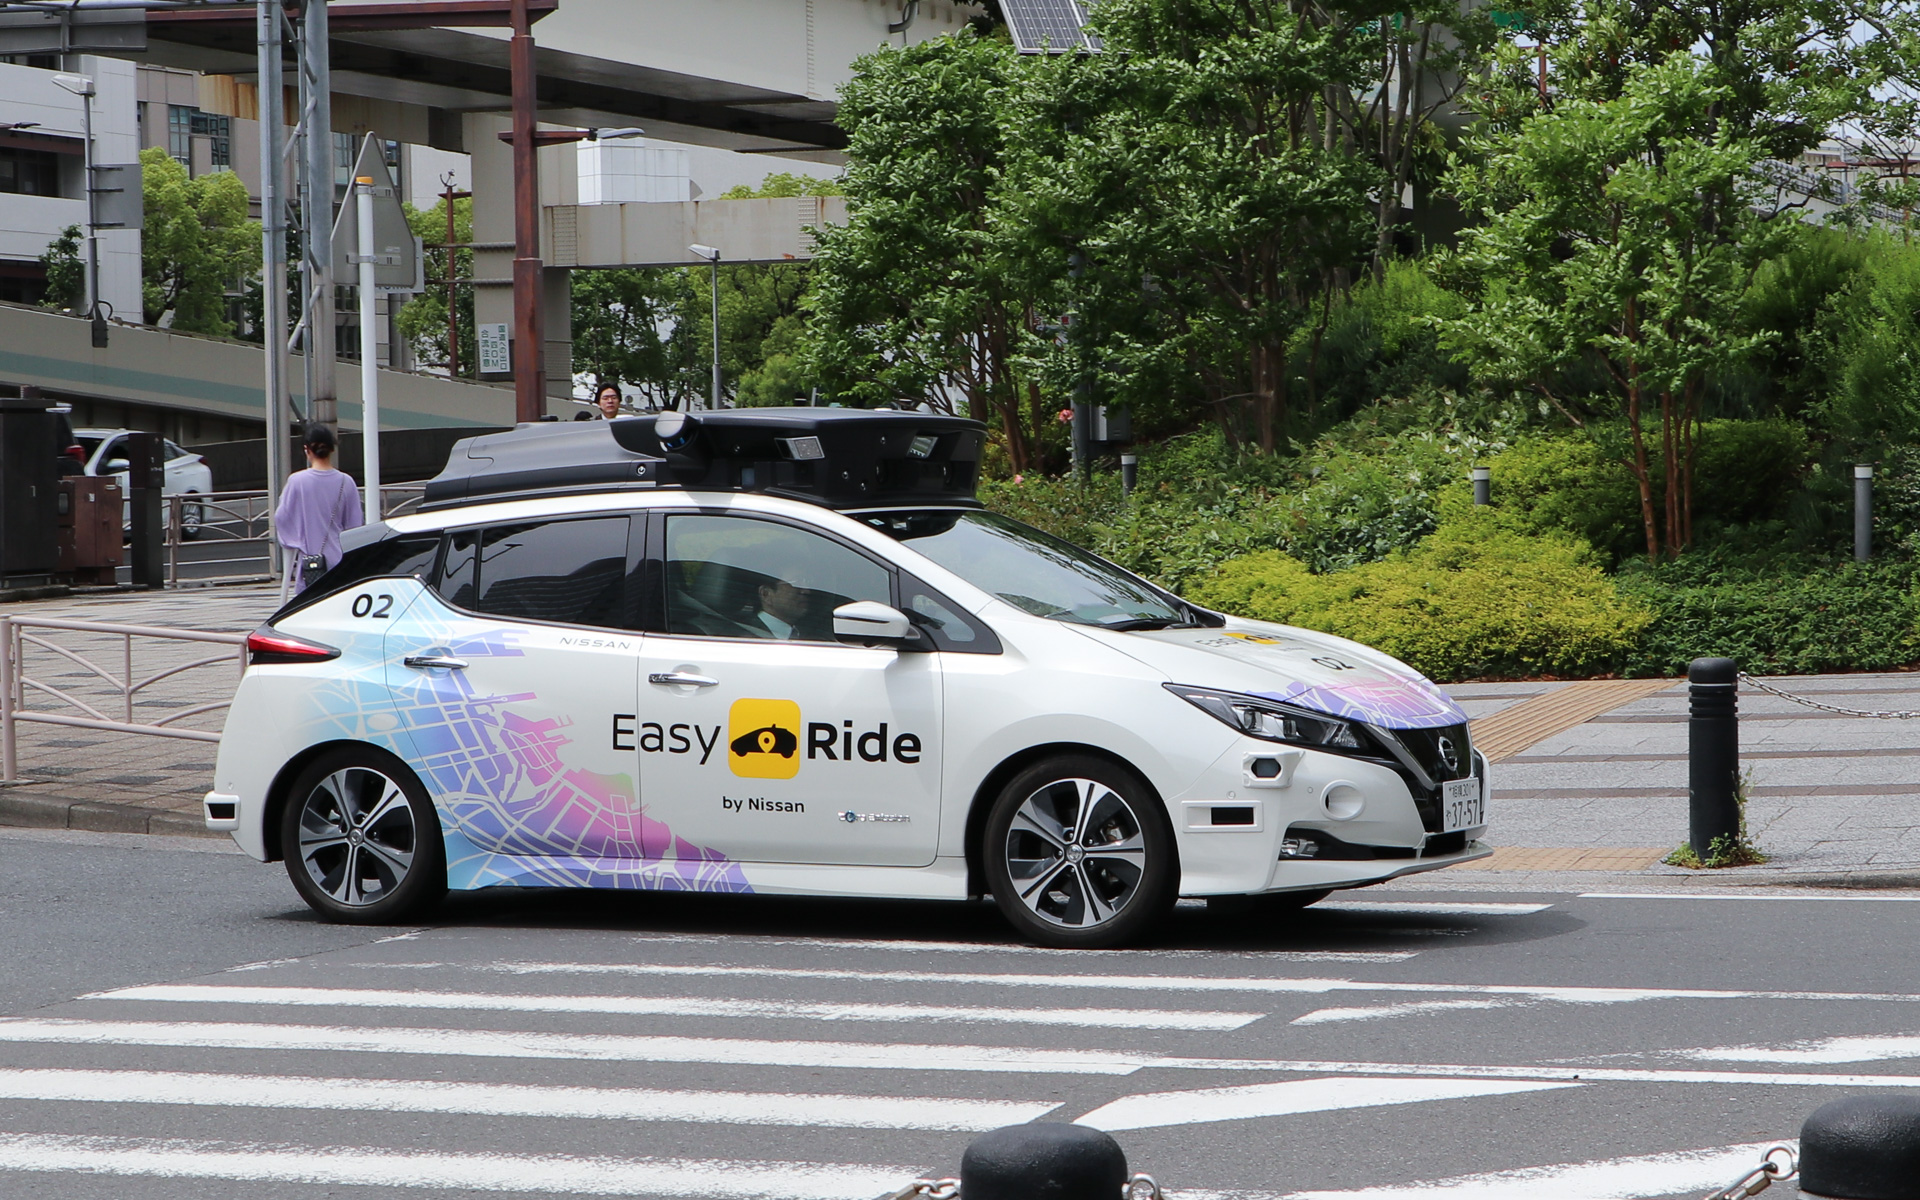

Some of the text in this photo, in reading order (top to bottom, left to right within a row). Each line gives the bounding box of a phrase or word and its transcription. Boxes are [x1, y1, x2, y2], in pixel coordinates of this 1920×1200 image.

[481, 329, 490, 367] 合流注意
[498, 325, 507, 370] 国道への出口
[351, 593, 394, 618] 02
[559, 637, 631, 650] NISSAN
[1311, 656, 1356, 671] 02
[612, 713, 922, 765] Easy Ride
[722, 795, 805, 813] by Nissan
